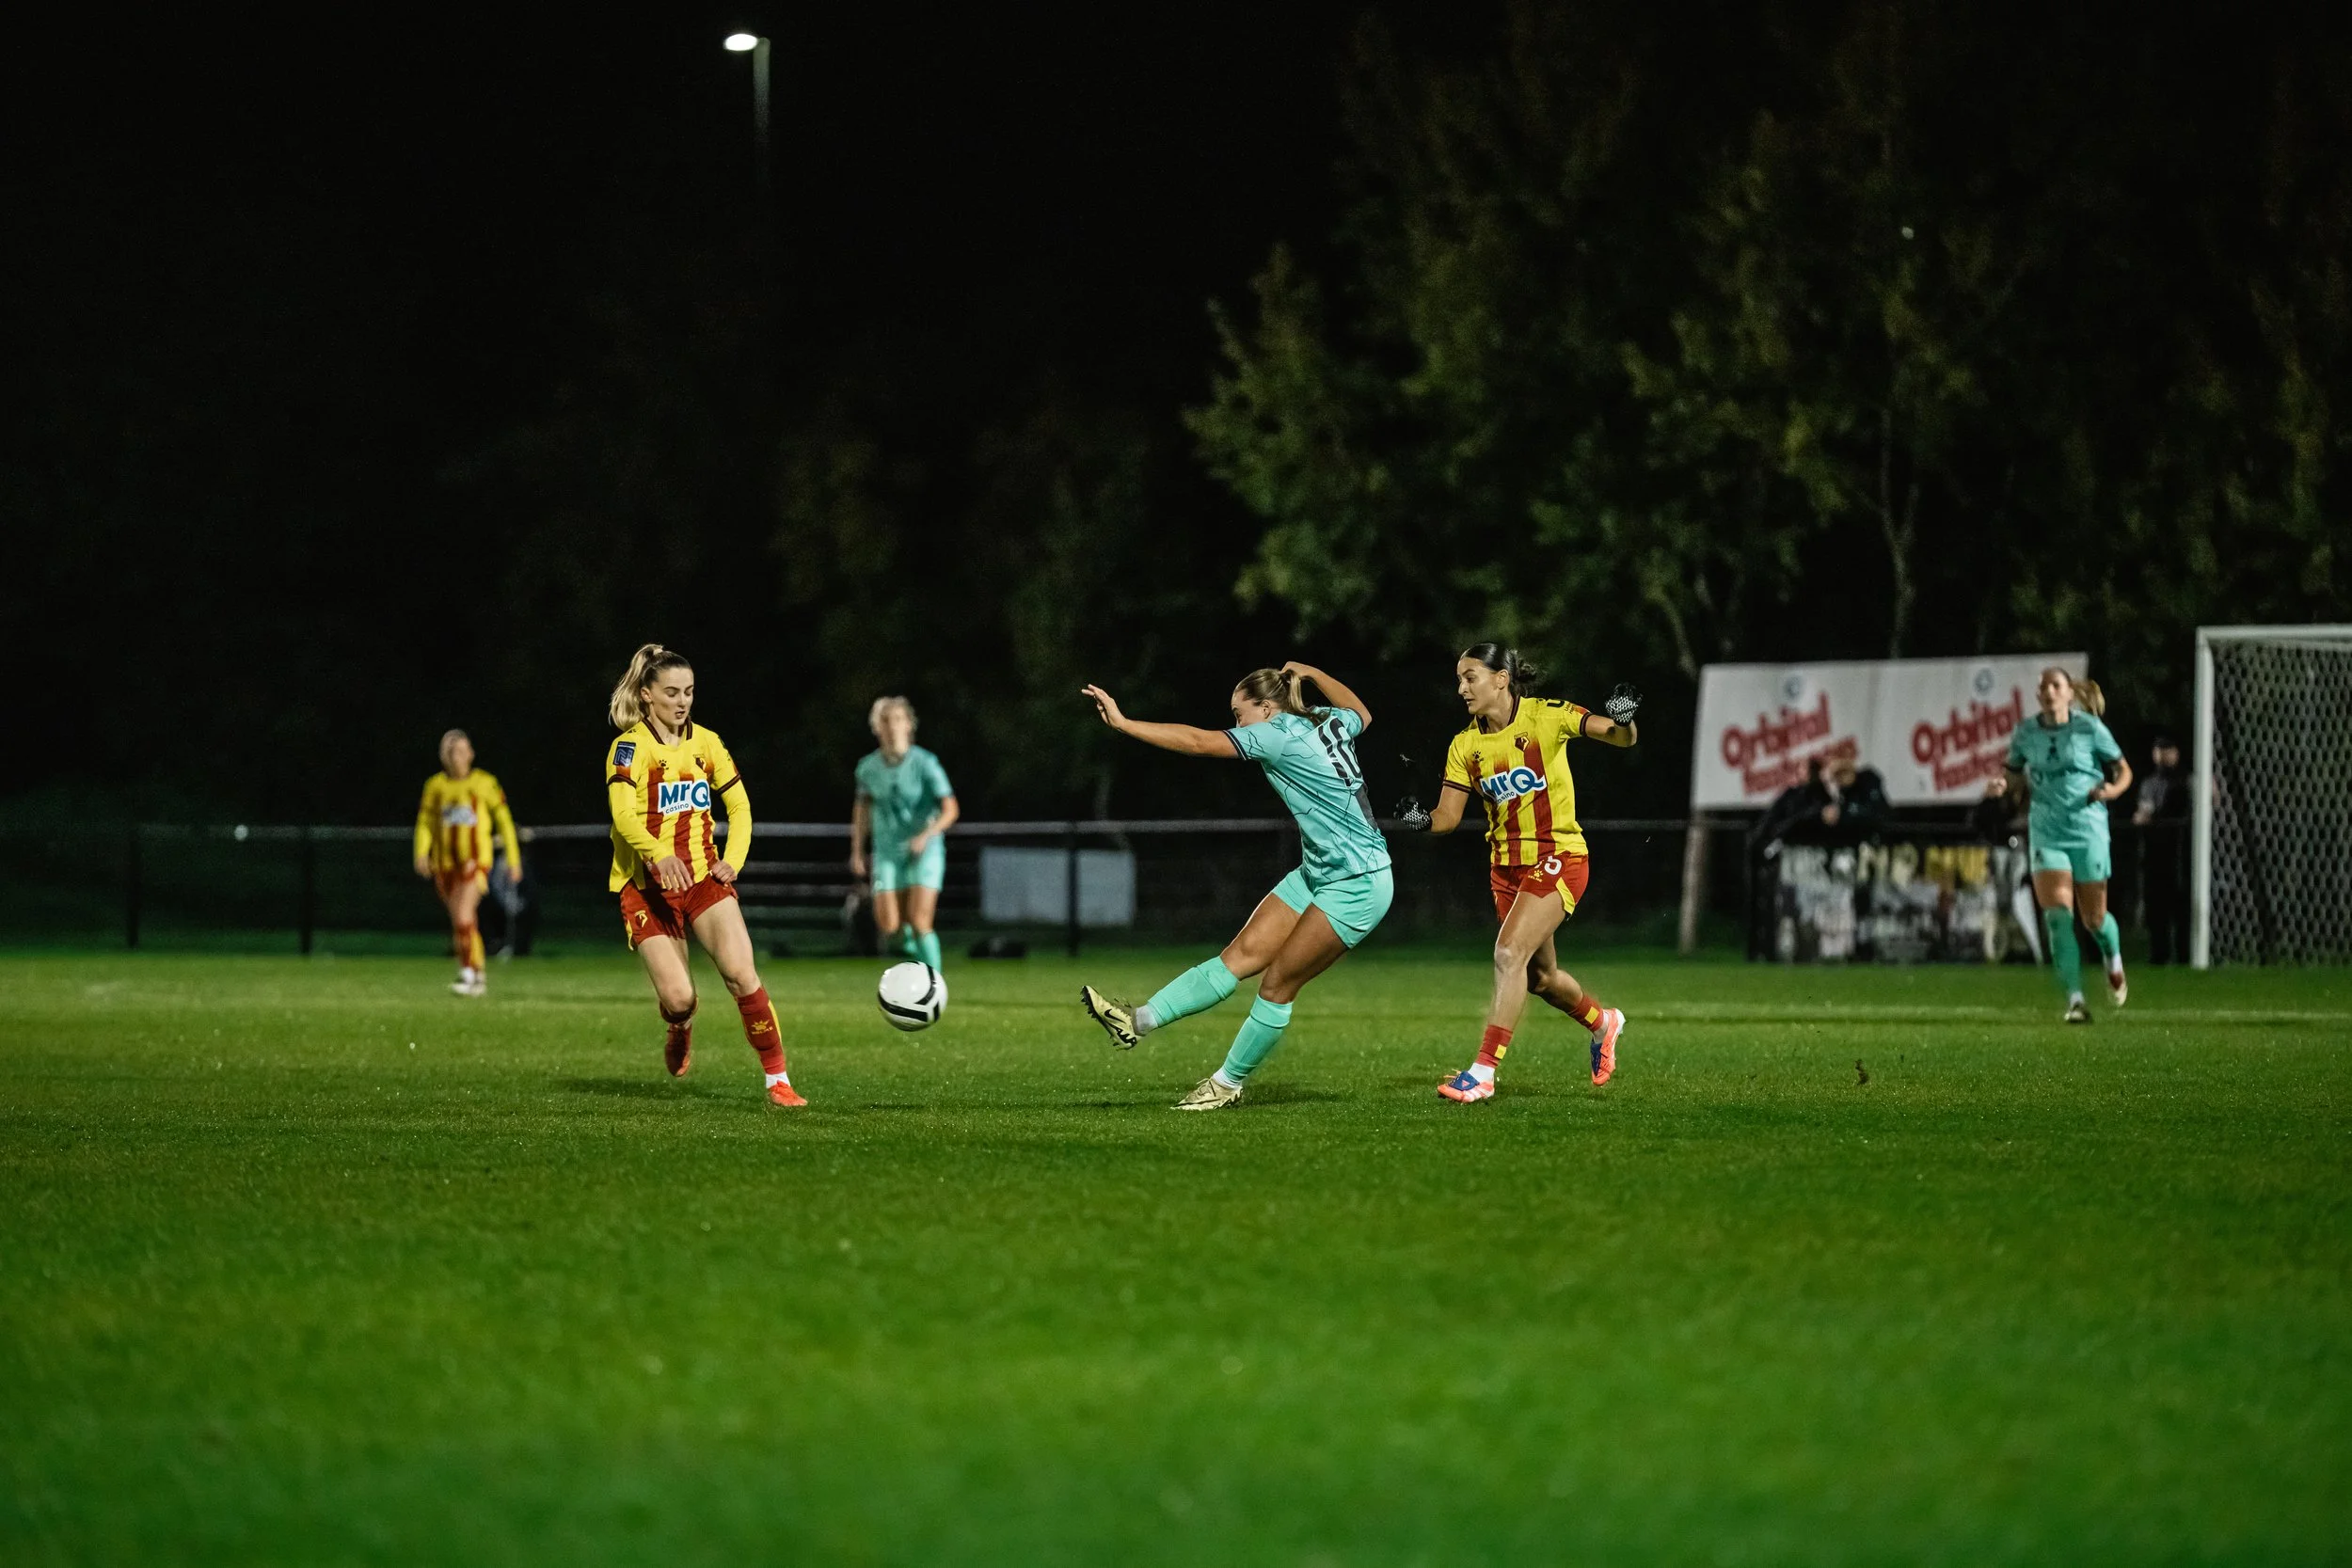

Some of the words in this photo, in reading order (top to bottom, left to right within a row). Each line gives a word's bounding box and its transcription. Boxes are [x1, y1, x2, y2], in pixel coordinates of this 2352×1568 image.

[1911, 687, 2022, 767] Orbital
[660, 782, 710, 808] MrQ
[1482, 768, 1545, 796] MrQ
[665, 803, 689, 814] casino
[1497, 791, 1515, 803] asino
